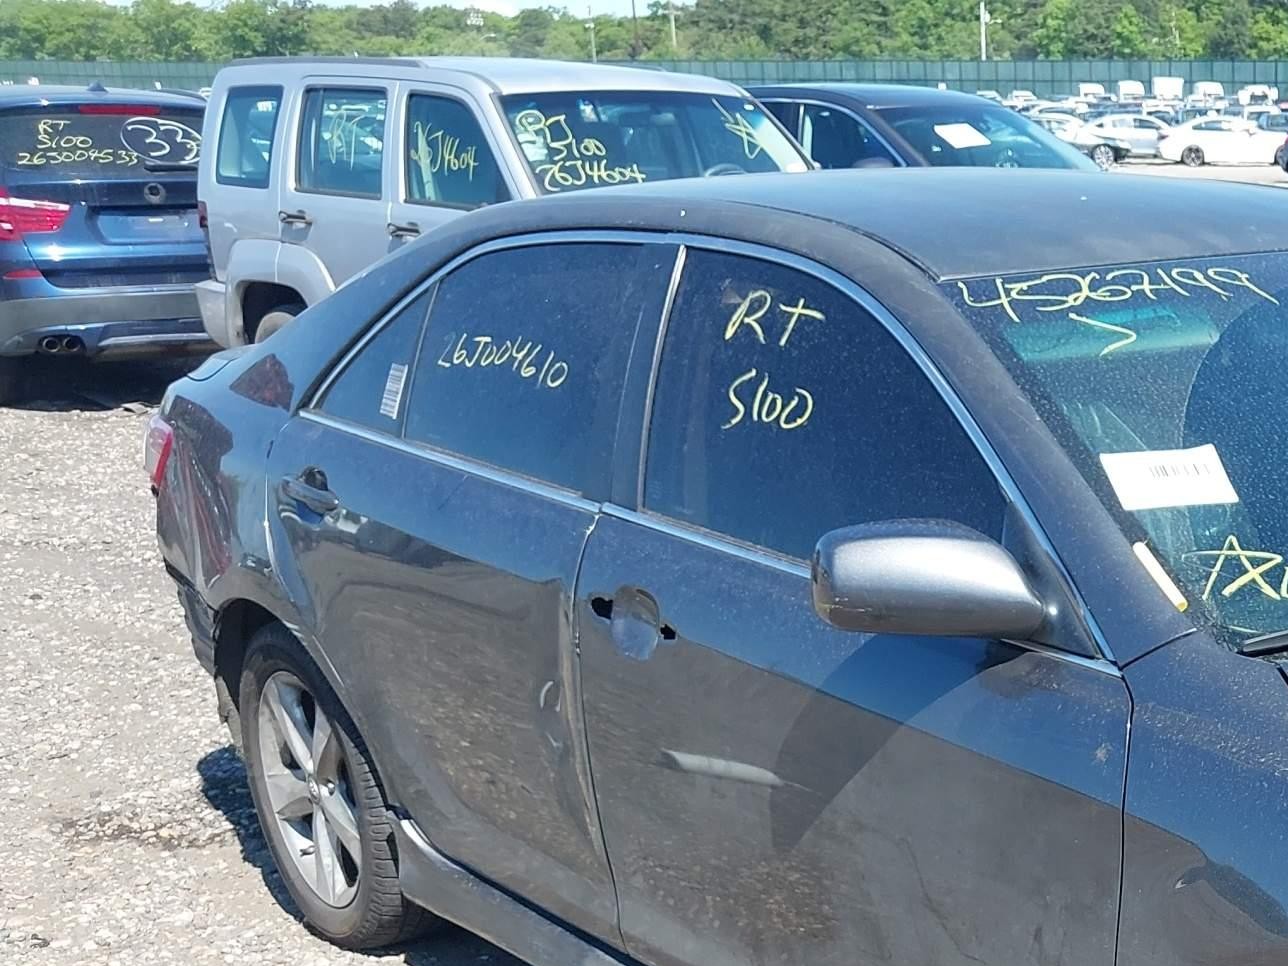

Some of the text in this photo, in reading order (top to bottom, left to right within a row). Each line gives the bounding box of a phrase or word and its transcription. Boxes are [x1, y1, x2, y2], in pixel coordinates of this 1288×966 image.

[37, 118, 71, 133] RT
[437, 333, 569, 388] 26J004610
[721, 368, 814, 429] S100
